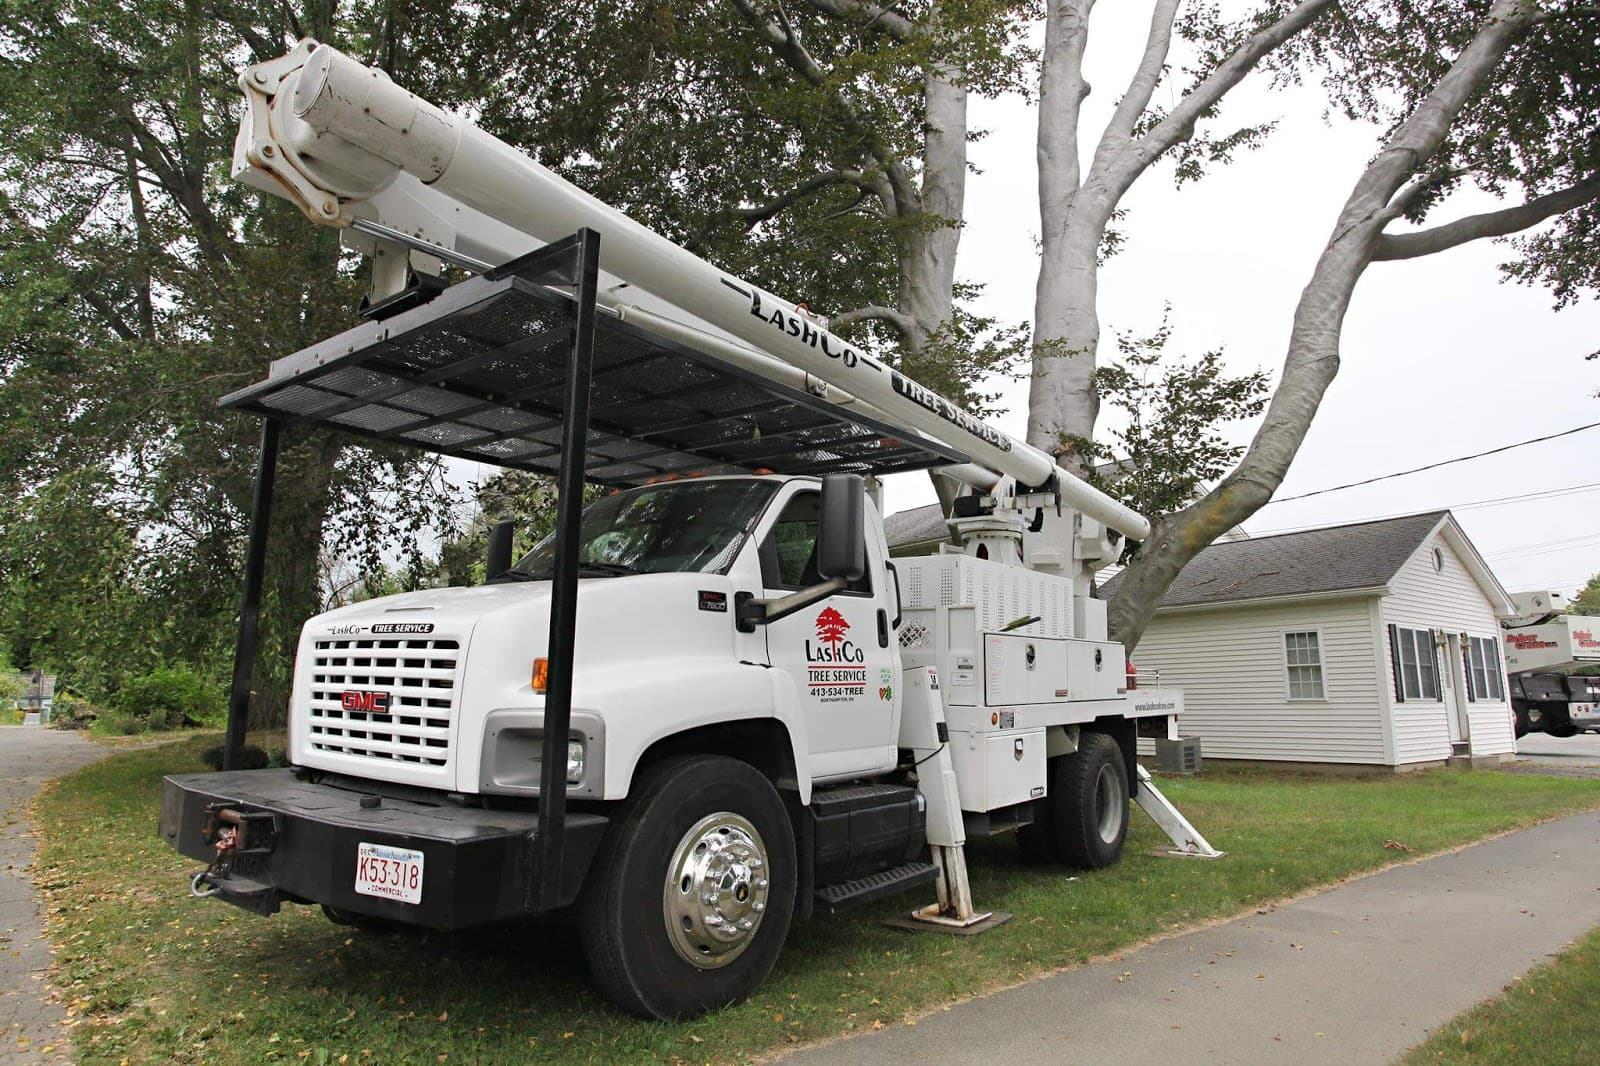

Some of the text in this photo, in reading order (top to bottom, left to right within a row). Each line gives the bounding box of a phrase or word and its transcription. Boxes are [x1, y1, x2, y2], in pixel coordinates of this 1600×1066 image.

[374, 624, 393, 633] TREE
[395, 624, 430, 633] SERVICE
[808, 670, 831, 682] TREE
[832, 670, 867, 682] SERVICE
[341, 689, 387, 712] GMC
[371, 884, 403, 897] COMMERCIAL
